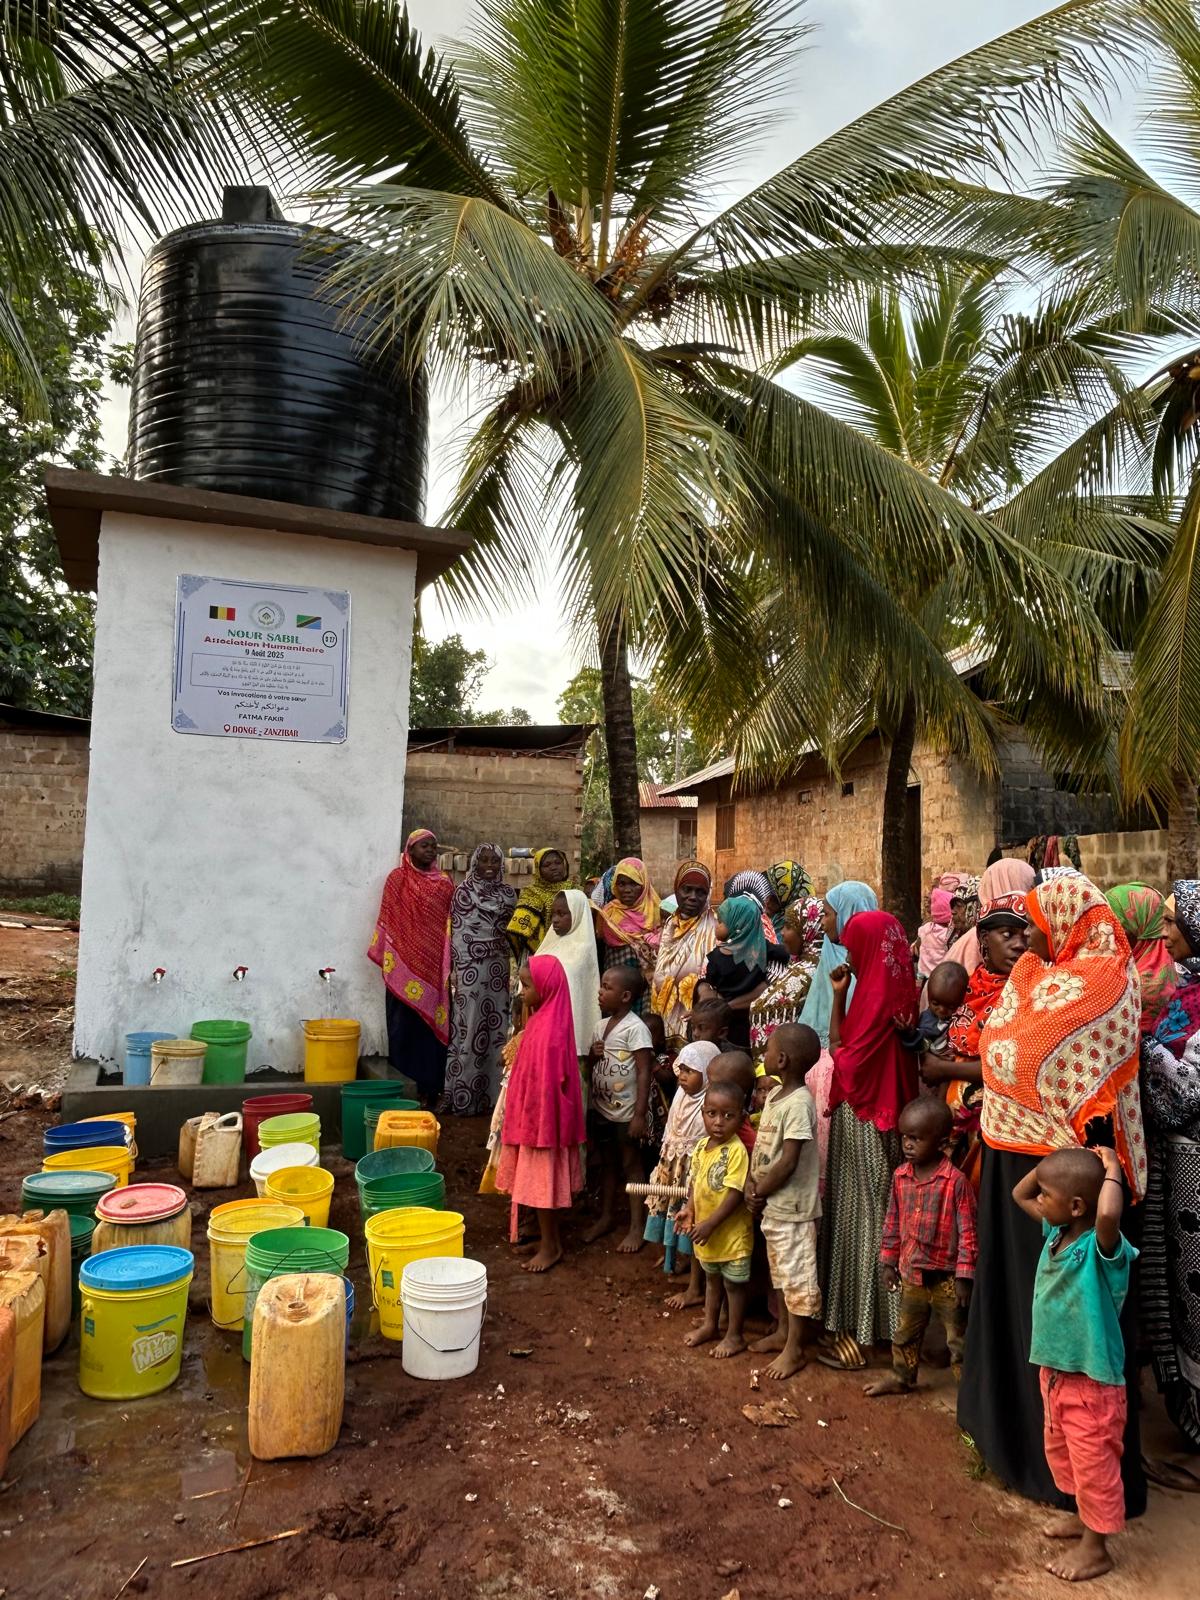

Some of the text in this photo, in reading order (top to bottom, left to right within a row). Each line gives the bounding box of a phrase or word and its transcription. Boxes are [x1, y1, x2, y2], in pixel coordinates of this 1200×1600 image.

[227, 629, 302, 645] NOUR SABIL
[204, 636, 325, 654] Association Humanitaire
[267, 651, 284, 659] 2025
[231, 690, 267, 700] invocations
[238, 713, 263, 721] FATMA
[232, 725, 257, 735] DONGE
[263, 728, 298, 737] ZANZIBAR
[135, 1332, 164, 1353] Fry
